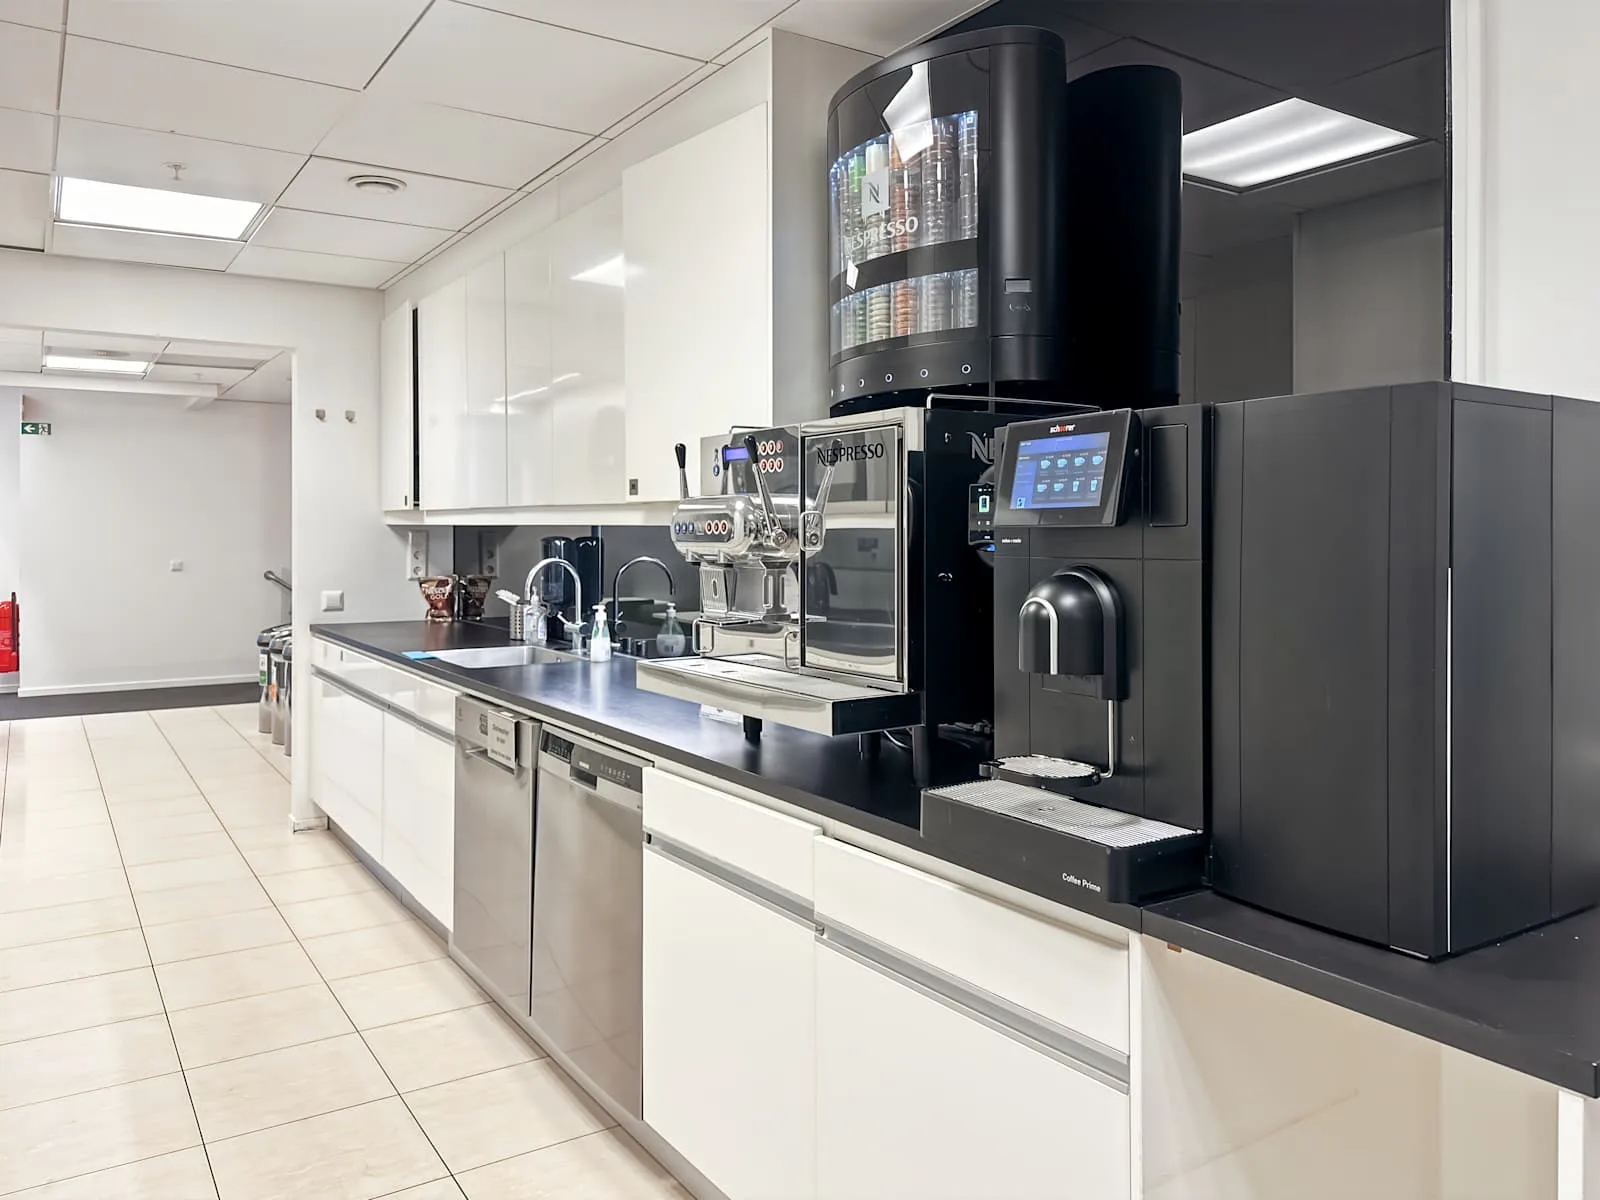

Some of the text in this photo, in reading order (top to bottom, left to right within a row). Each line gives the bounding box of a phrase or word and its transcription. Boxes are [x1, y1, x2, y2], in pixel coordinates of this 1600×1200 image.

[868, 181, 880, 204] N
[816, 443, 884, 467] NESPRESSO
[1062, 872, 1101, 893] Coffee Prime
